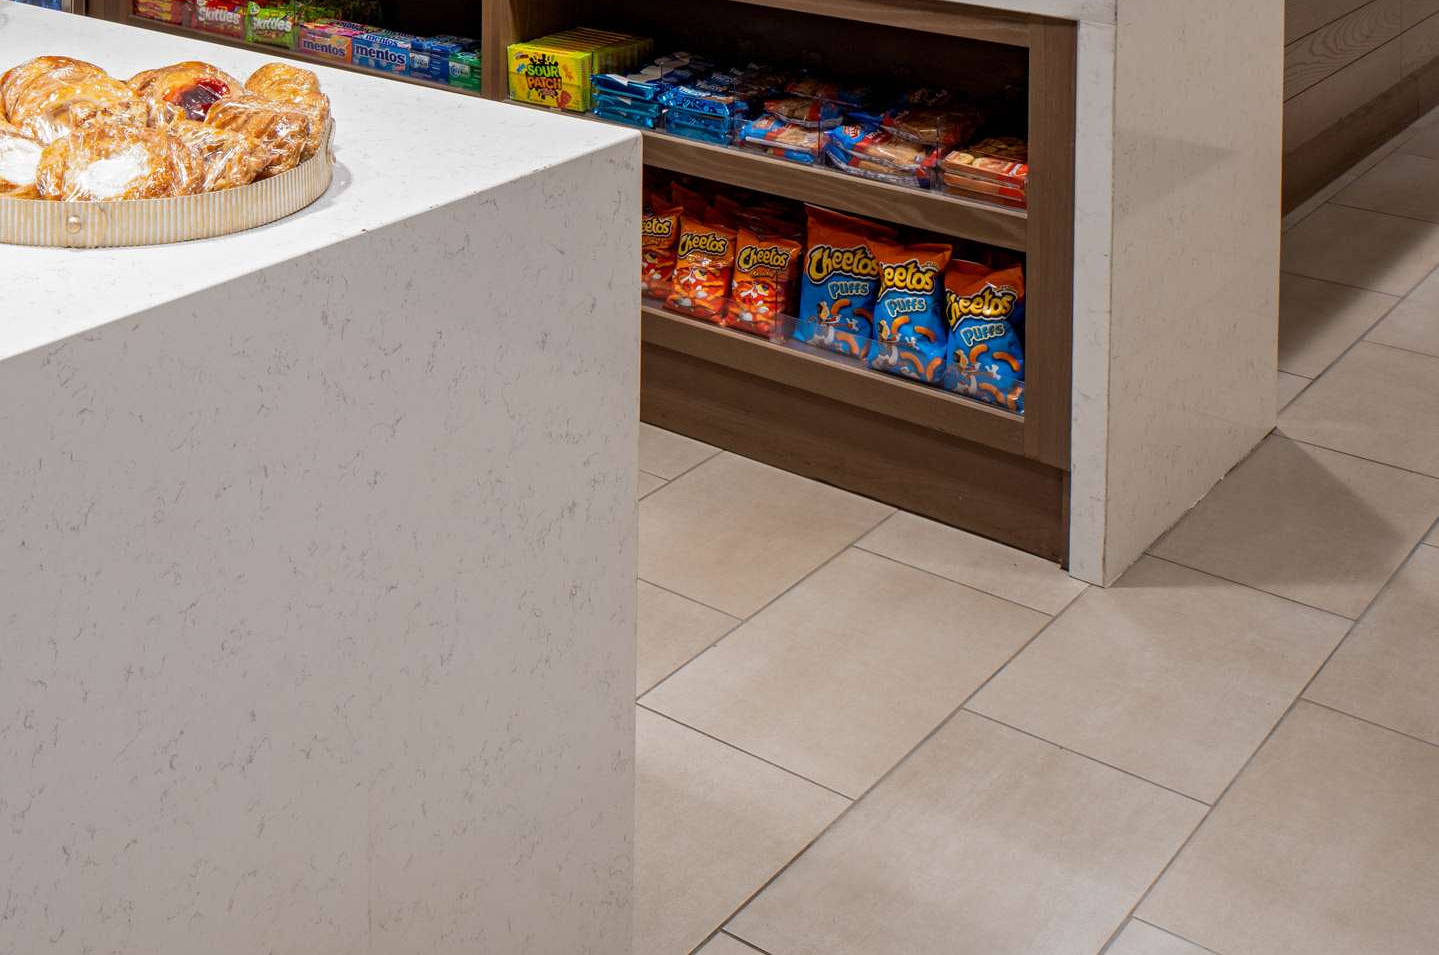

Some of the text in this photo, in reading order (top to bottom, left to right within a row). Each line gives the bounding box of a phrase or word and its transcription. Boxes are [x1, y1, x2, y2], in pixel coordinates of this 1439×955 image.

[197, 6, 241, 24] Skittles
[303, 38, 347, 57] mentos
[364, 33, 398, 47] mentos
[354, 44, 407, 65] mentos
[527, 64, 560, 77] SOUR
[527, 76, 562, 90] PATCH
[642, 218, 673, 236] eetos
[677, 232, 728, 257] Cheetos
[737, 246, 790, 271] Cheetos
[808, 244, 880, 283] Cheetos
[881, 260, 938, 294] eetos
